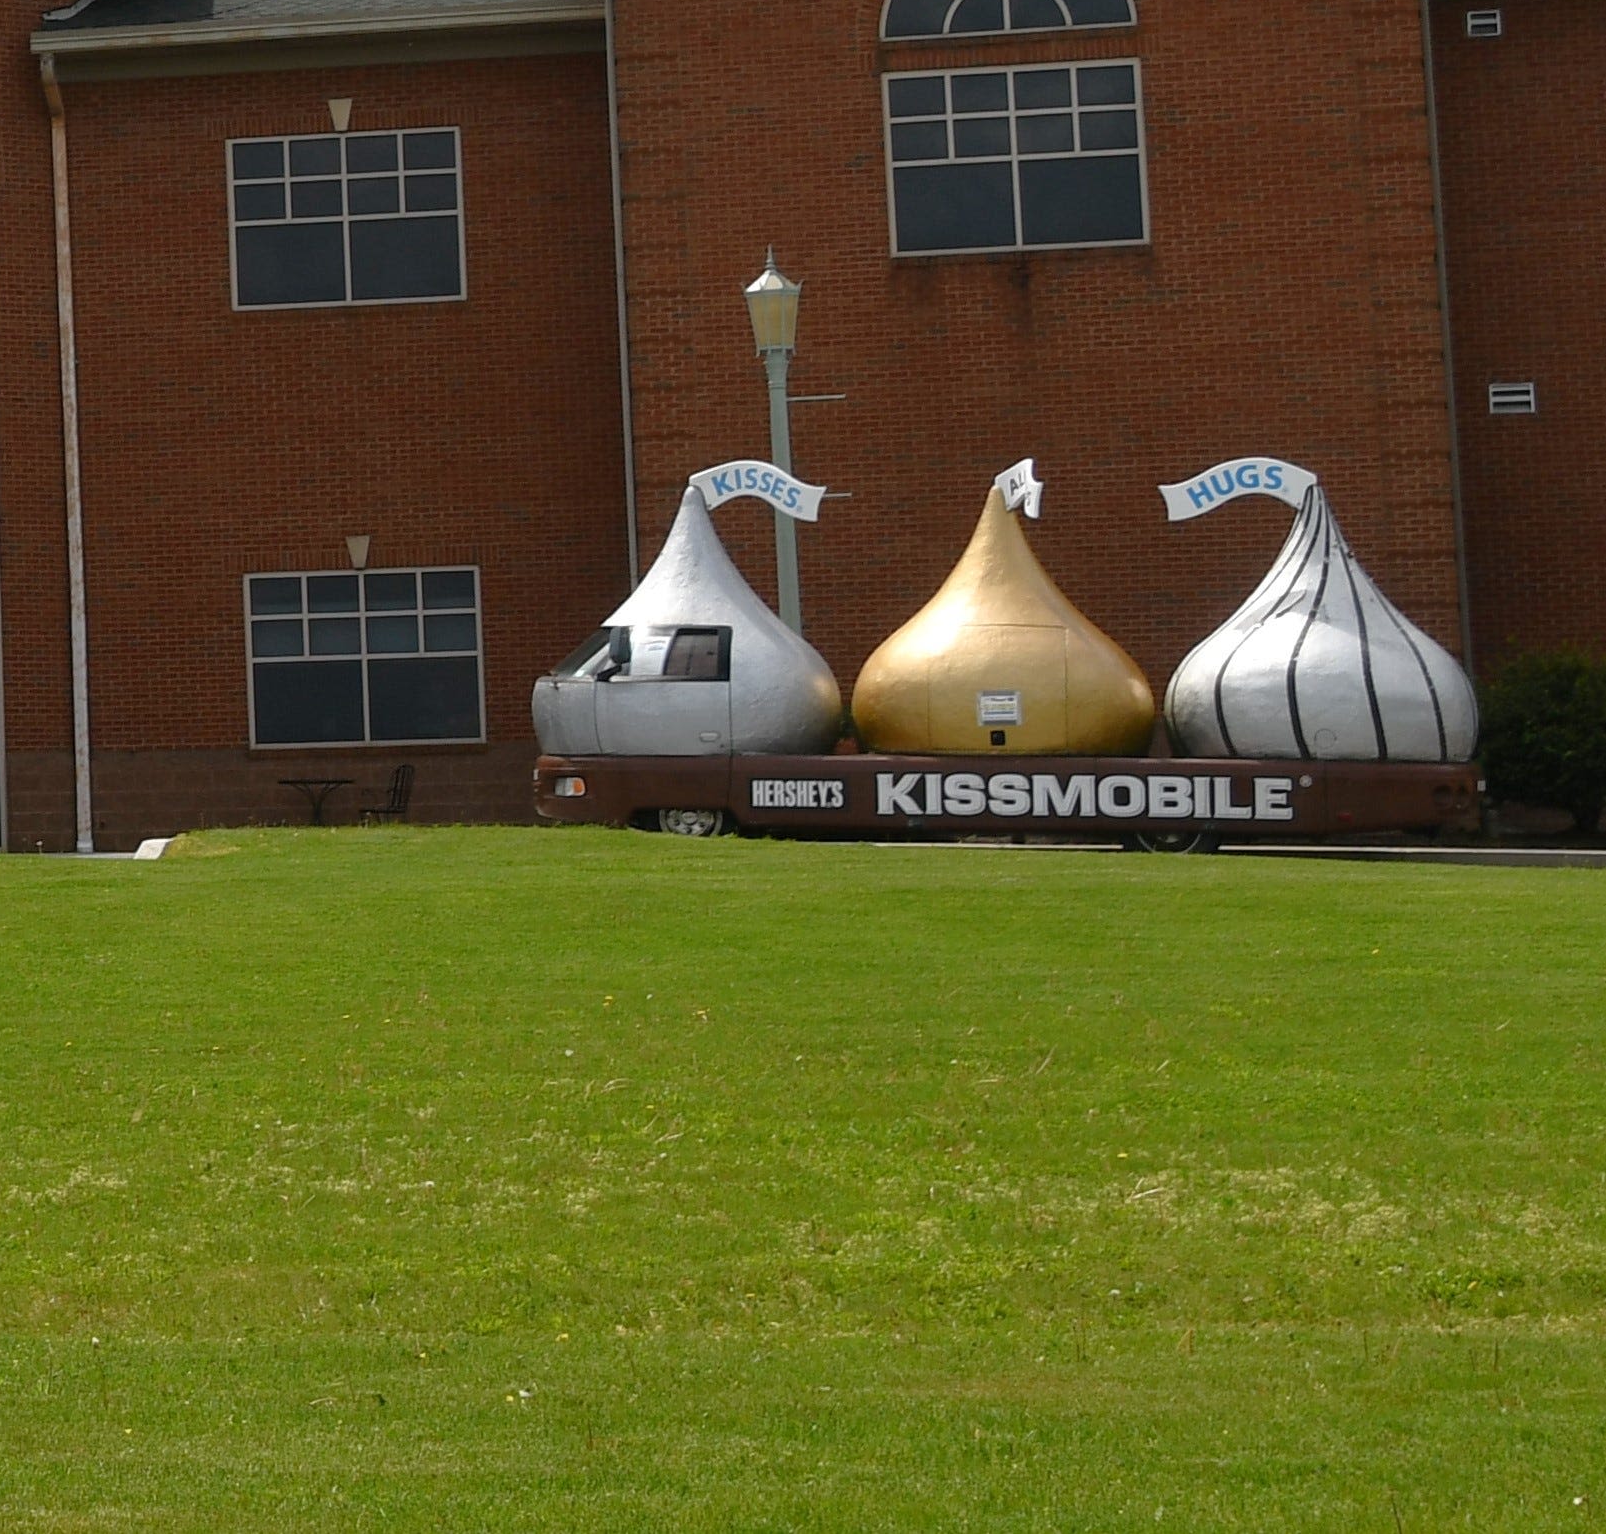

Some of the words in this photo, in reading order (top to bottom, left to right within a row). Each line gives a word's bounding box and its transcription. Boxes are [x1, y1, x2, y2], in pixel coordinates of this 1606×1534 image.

[711, 468, 801, 508] KISSES
[1186, 464, 1283, 509] HUGS
[751, 780, 845, 808] HERSHEY'S
[876, 772, 1294, 820] KISSMOBILE
